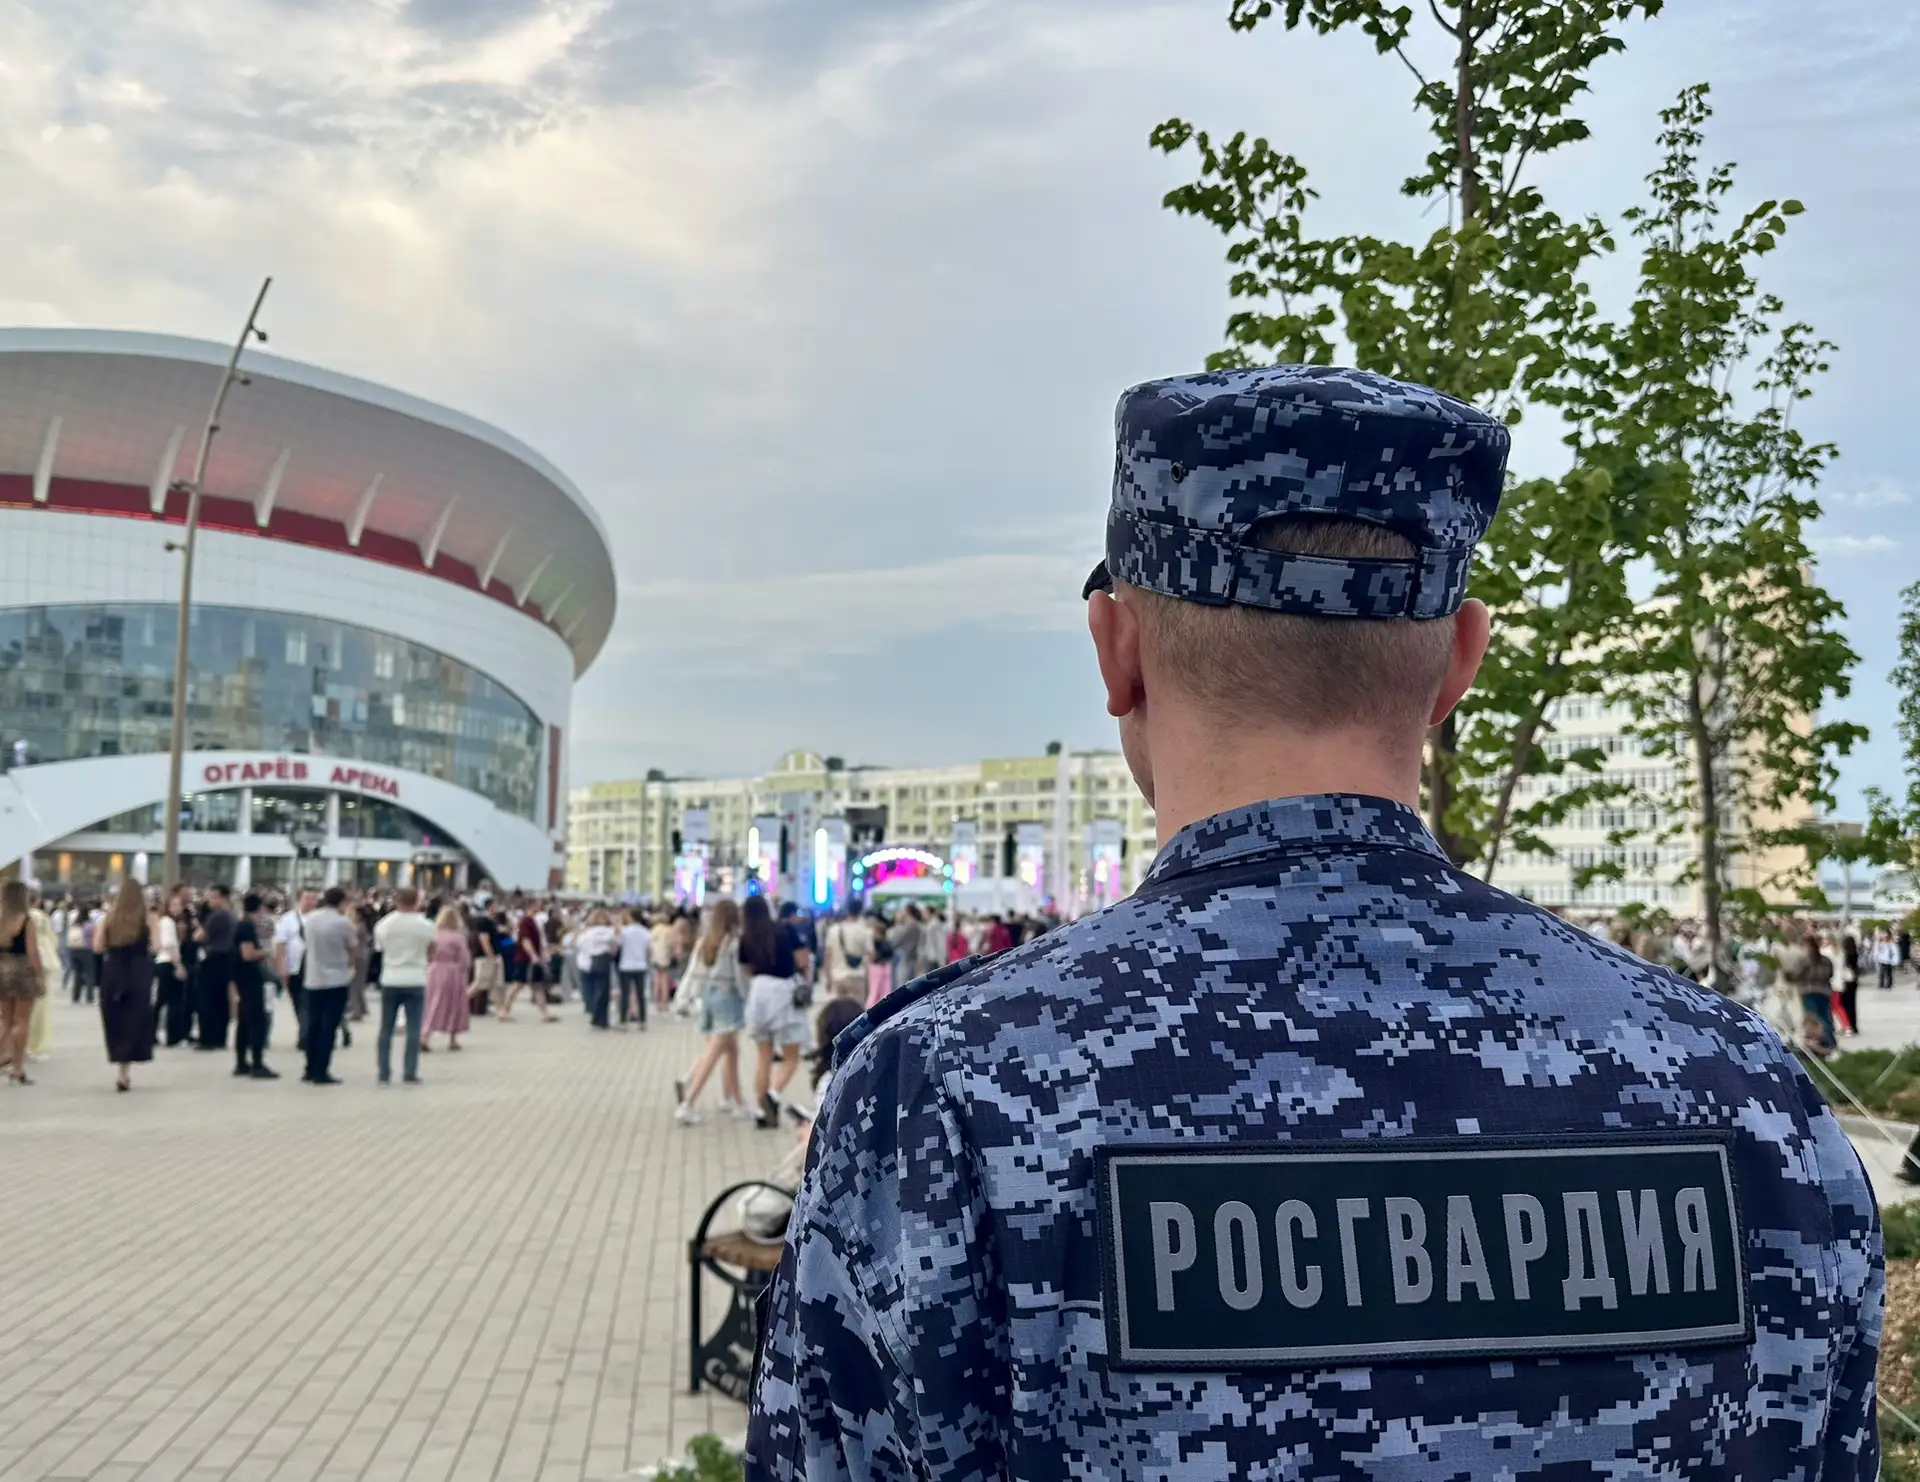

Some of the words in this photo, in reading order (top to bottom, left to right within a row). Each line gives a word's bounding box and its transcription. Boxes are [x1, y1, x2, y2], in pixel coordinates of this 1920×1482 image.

[204, 757, 308, 783] ОГАРЁВ
[331, 765, 399, 797] АРЕНА
[1149, 1186, 1717, 1311] РОСГВАРДИЯ
